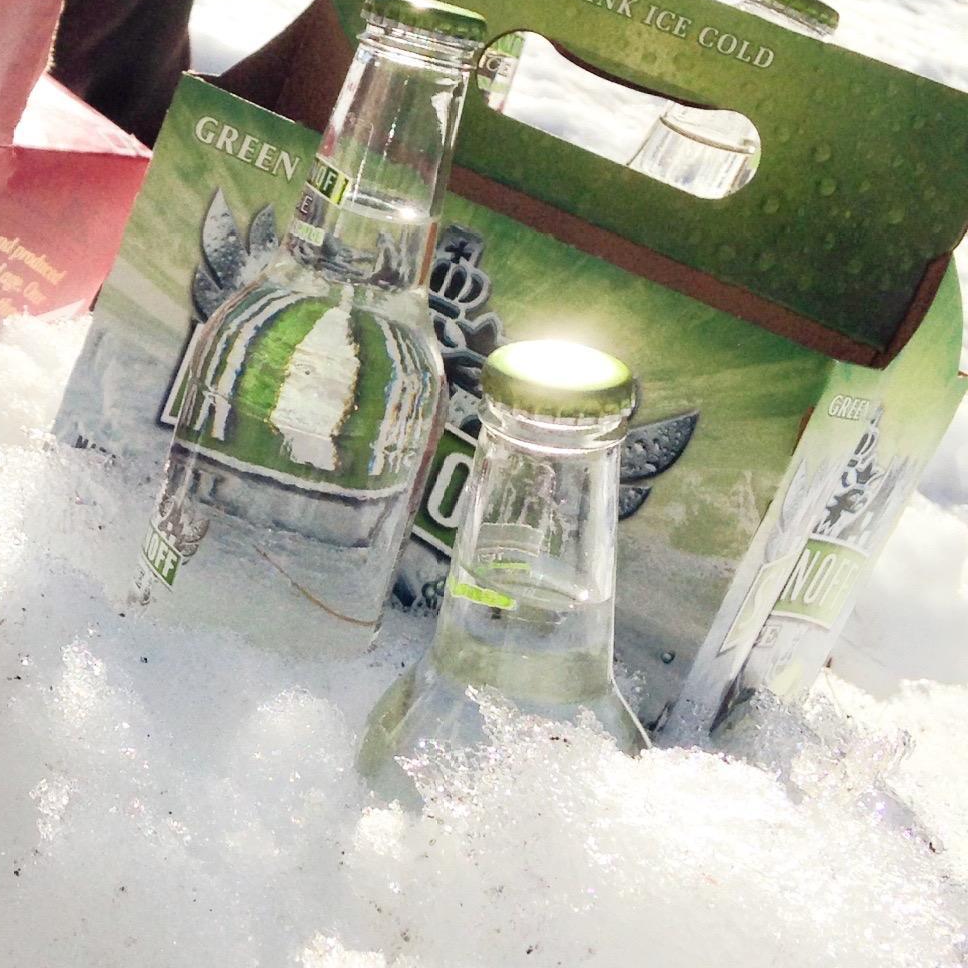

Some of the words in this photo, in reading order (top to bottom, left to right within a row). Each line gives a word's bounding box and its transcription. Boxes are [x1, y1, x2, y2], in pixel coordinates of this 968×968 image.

[641, 4, 692, 39] ICE
[698, 26, 776, 70] COLD
[194, 115, 303, 184] GREEN
